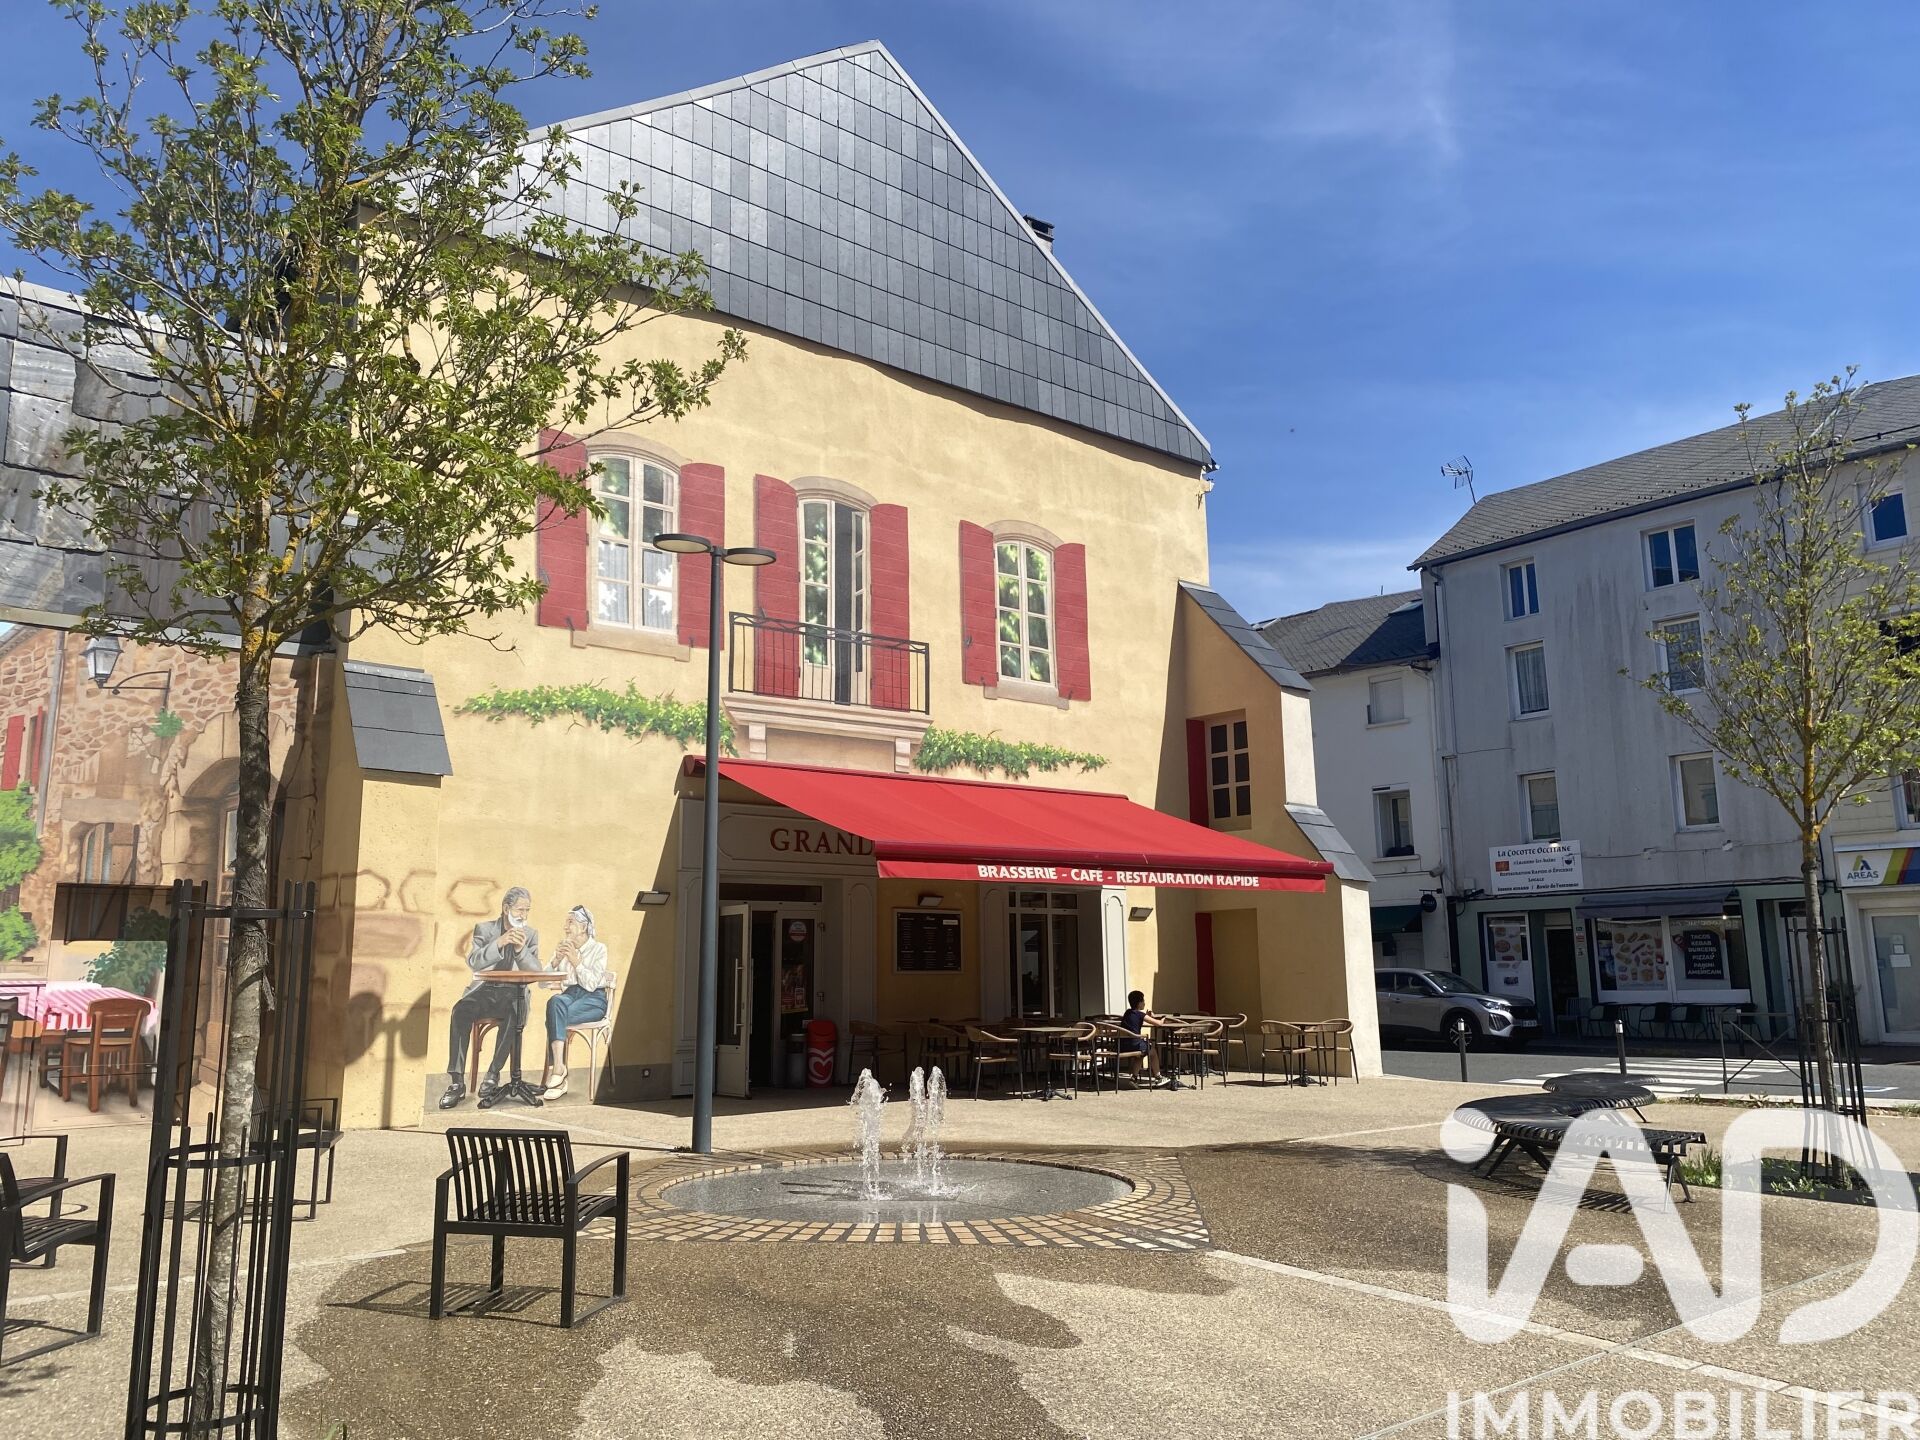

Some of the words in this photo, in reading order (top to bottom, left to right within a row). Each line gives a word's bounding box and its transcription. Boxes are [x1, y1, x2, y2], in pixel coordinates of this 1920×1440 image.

[1507, 848, 1536, 857] COCOTTE
[977, 865, 1058, 879] BRASSERIE
[1116, 871, 1213, 885] RESTAURATION
[1217, 874, 1259, 887] RAPIDE
[1847, 871, 1879, 880] AREAS
